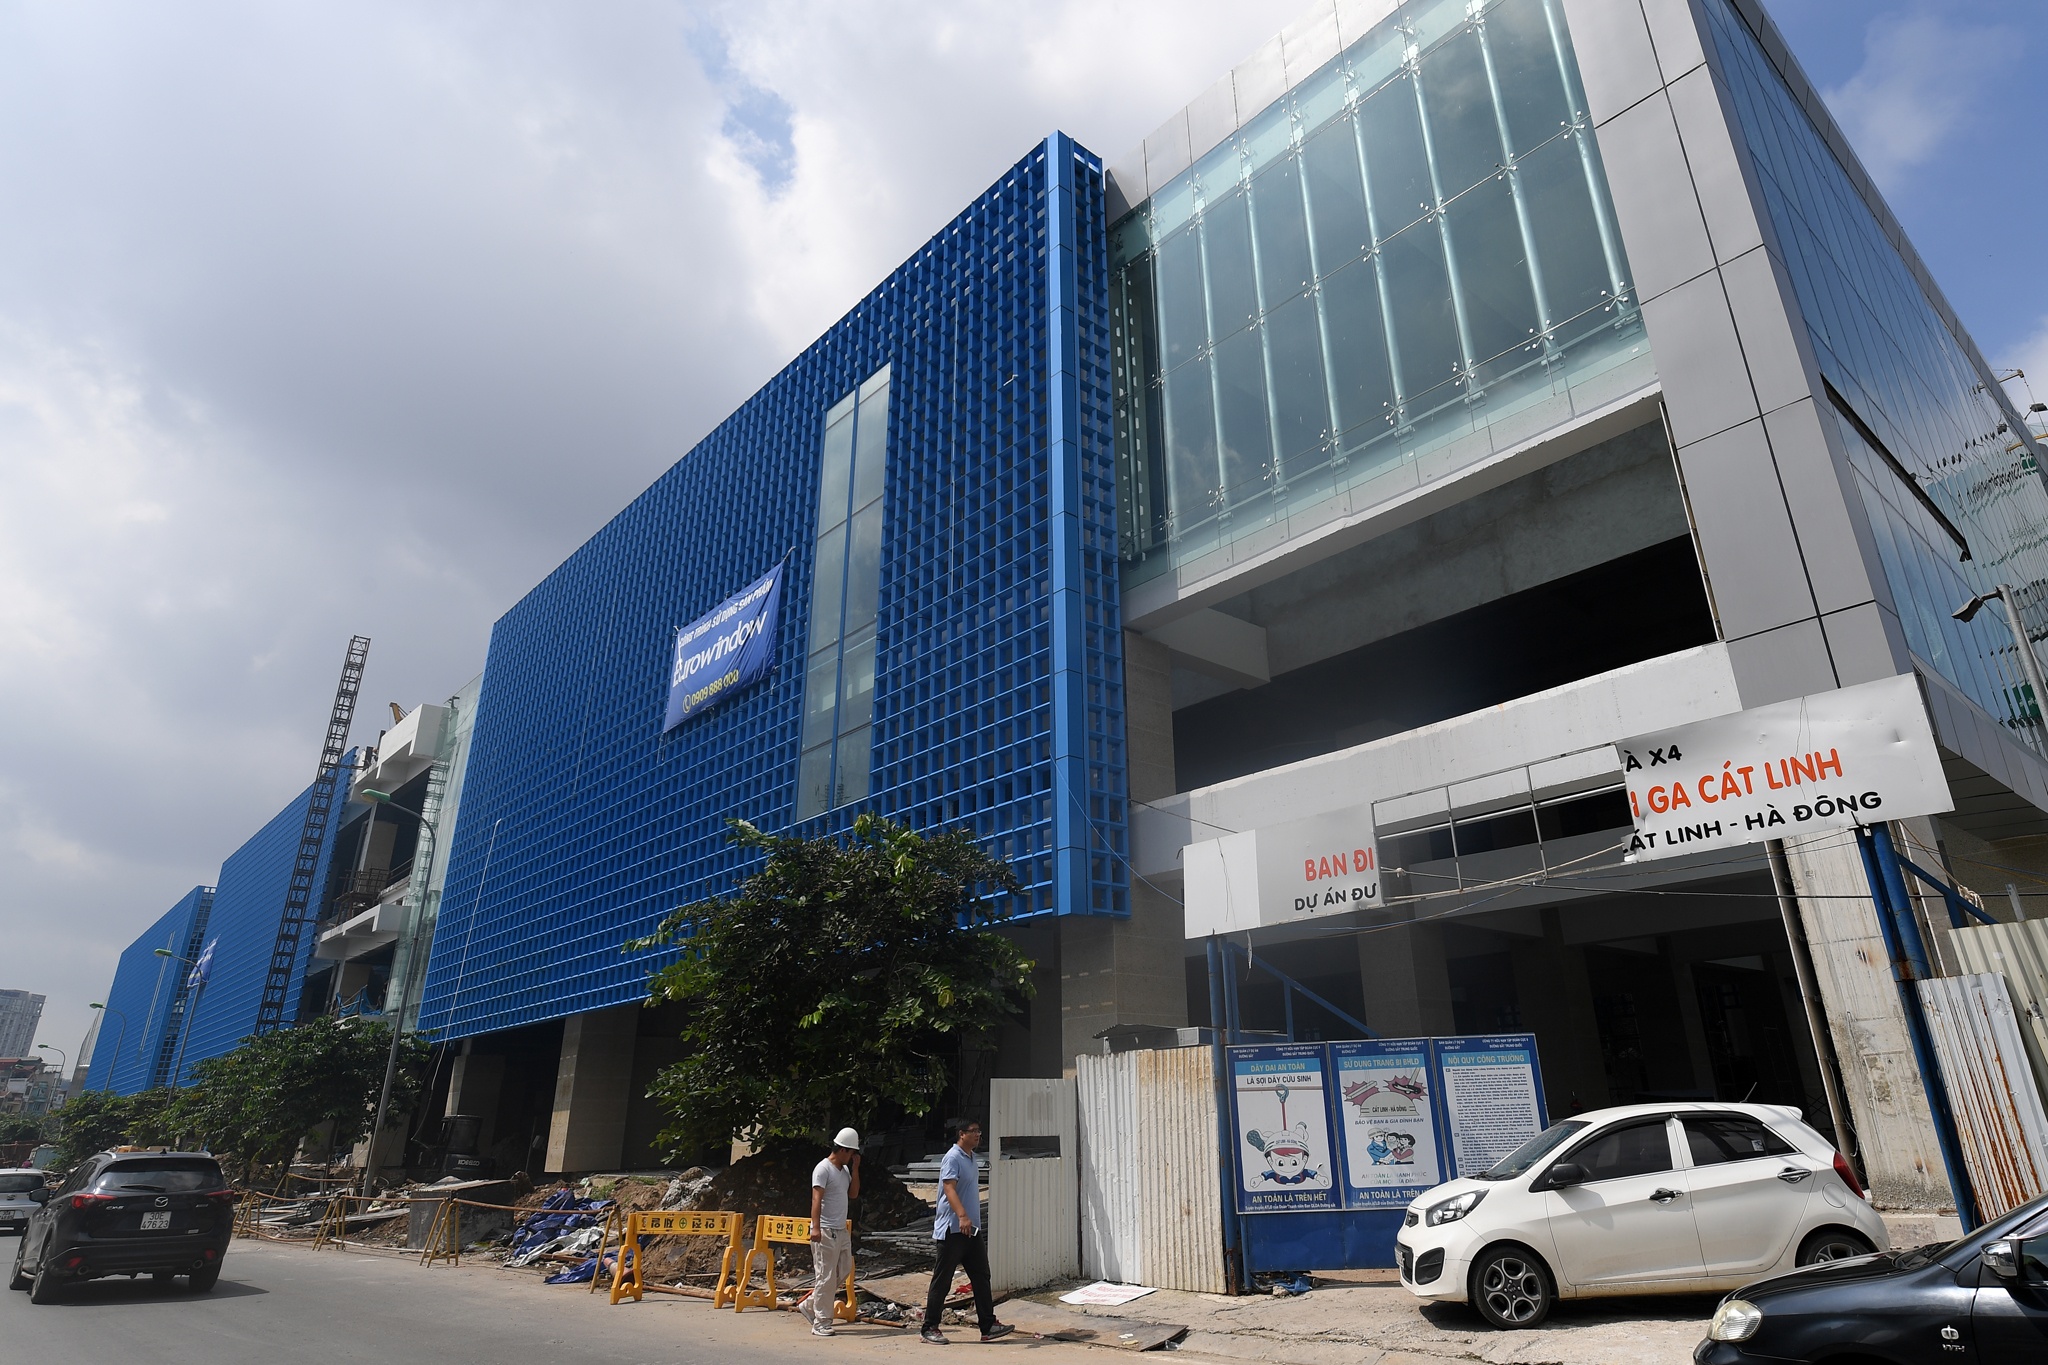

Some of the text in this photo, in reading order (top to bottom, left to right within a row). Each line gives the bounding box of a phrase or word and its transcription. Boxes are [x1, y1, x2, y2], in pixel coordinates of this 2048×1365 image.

[691, 686, 708, 705] 0909
[709, 678, 723, 695] 888
[1649, 745, 1682, 767] X4
[1648, 782, 1691, 813] GA
[1698, 761, 1753, 803] CÁT
[1764, 748, 1843, 790] LINH
[1623, 829, 1656, 853] ÁT
[1665, 821, 1722, 845] LINH
[1745, 804, 1786, 831] HÀ
[1793, 792, 1882, 821] ĐÔNG
[1305, 847, 1374, 881] BAN ĐI
[1295, 883, 1376, 912] DỰ ÁN ĐƯ
[1373, 1059, 1394, 1067] TRANG
[1461, 1056, 1474, 1064] QUY
[1476, 1054, 1495, 1063] CÔNG
[1497, 1053, 1524, 1062] TRƯỜNG
[1287, 1062, 1305, 1070] TOÀN
[1246, 1076, 1255, 1084] LÀ
[1268, 1075, 1281, 1084] DÂY
[1296, 1075, 1312, 1083] SINH
[1252, 1190, 1327, 1203] AN TOÀN LÀ TRÊN HẾT
[1370, 1189, 1390, 1199] TOÀN
[1391, 1189, 1401, 1198] LÀ
[149, 1211, 164, 1220] 30E
[776, 1222, 793, 1235] 안전
